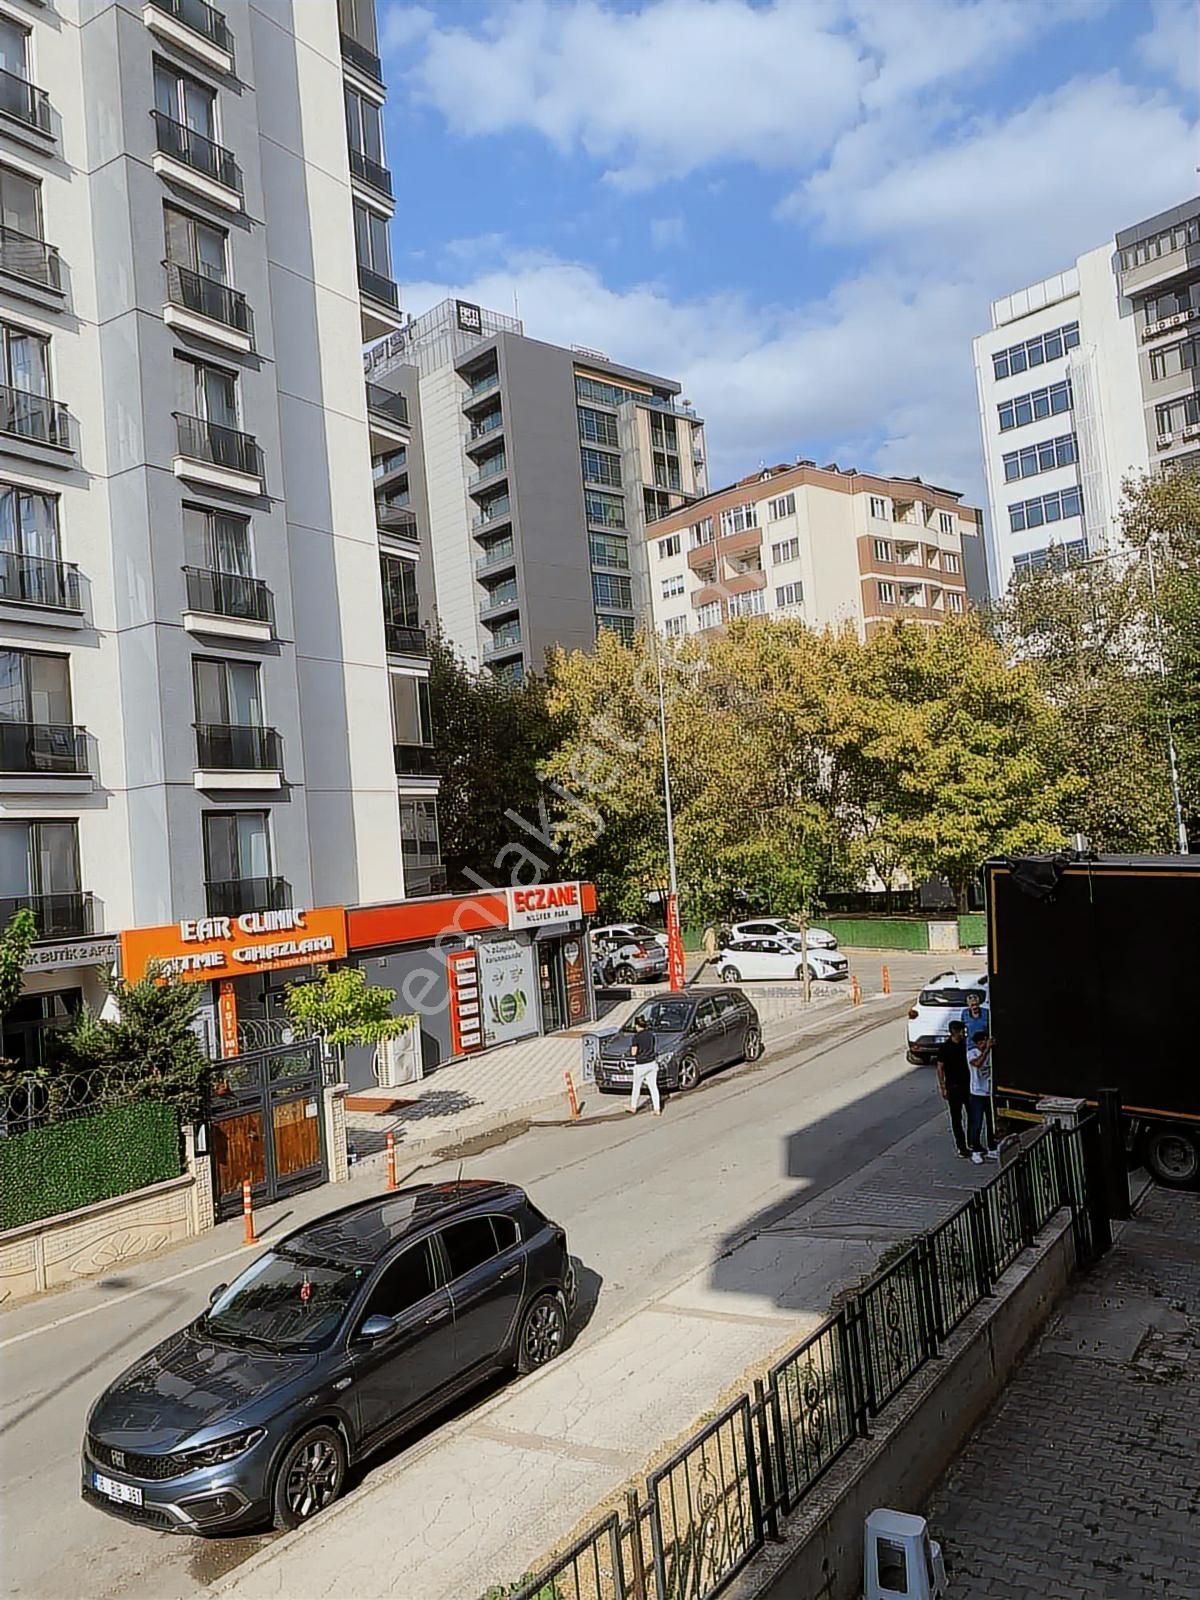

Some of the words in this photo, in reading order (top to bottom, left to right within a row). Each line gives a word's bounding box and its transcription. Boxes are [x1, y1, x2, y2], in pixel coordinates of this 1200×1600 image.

[514, 886, 578, 912] ECZANE
[180, 916, 232, 942] EAR
[238, 908, 306, 933] CLINIC
